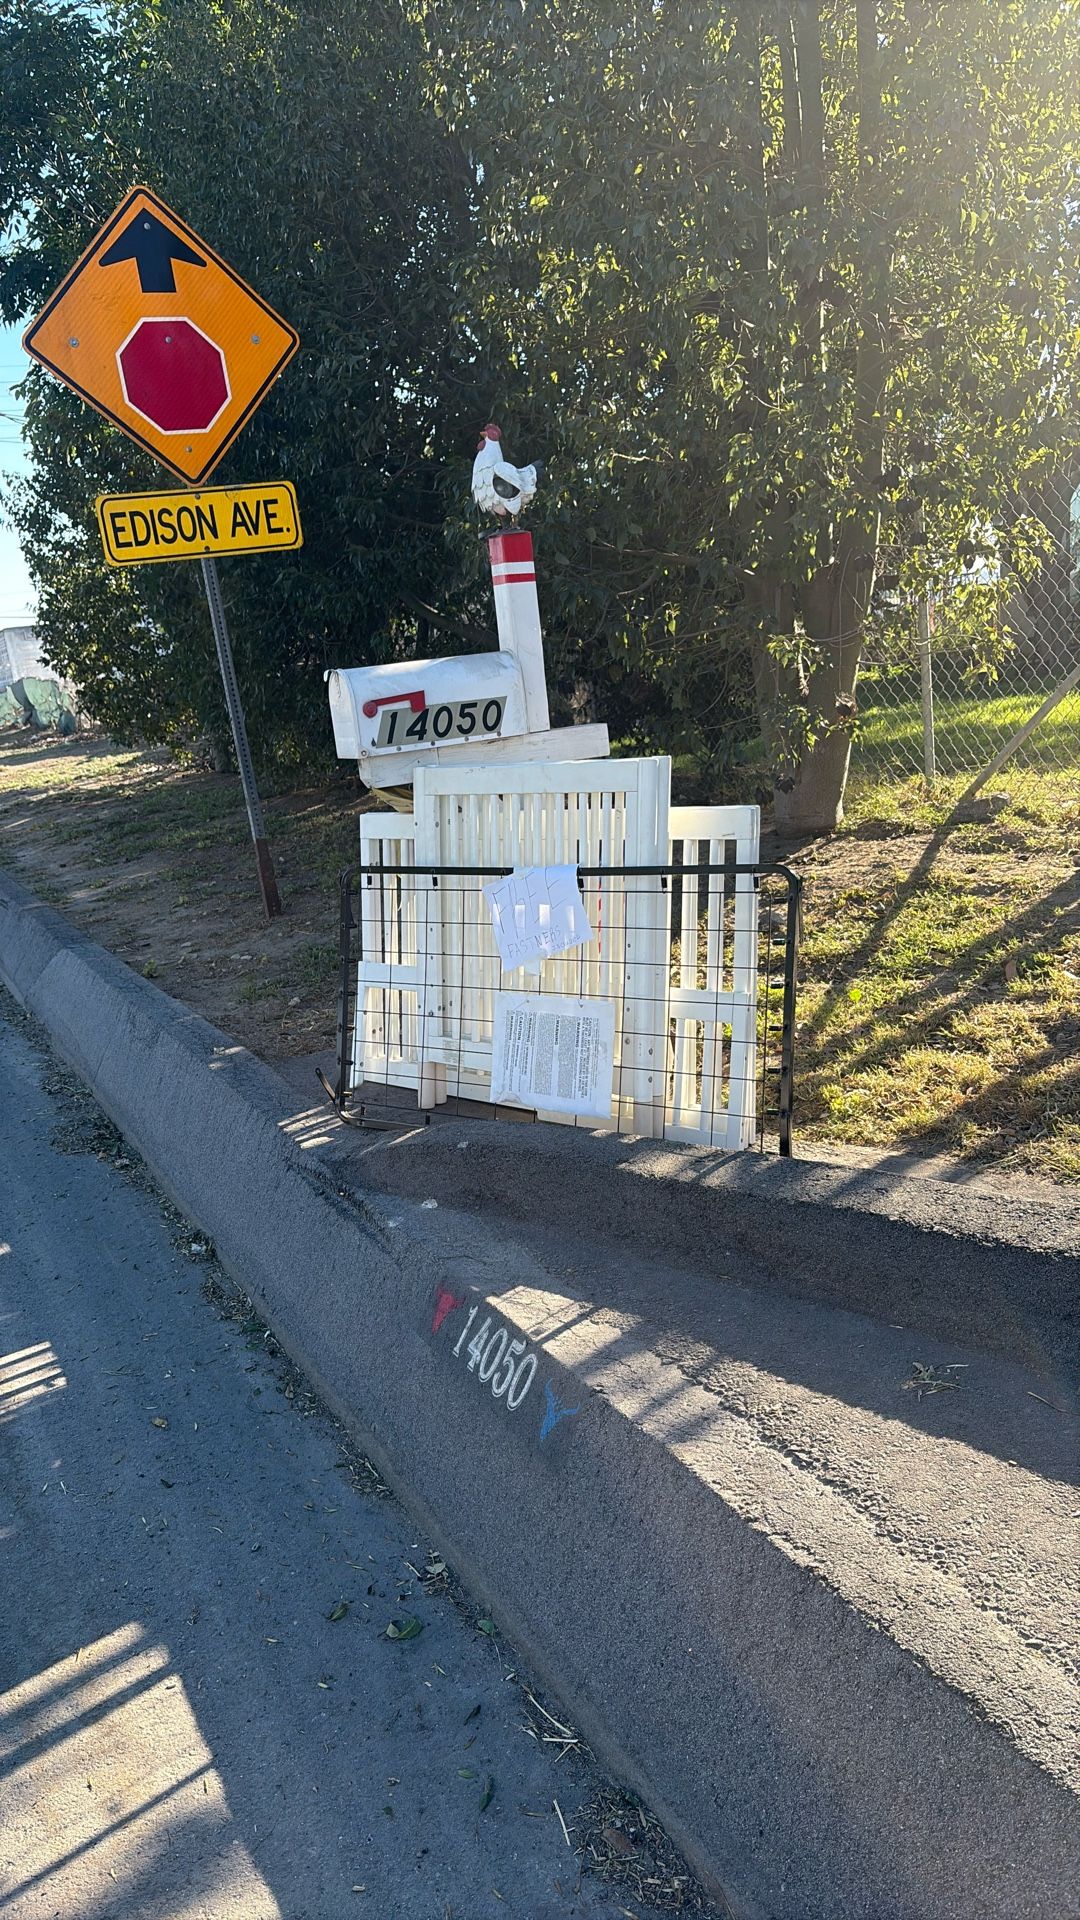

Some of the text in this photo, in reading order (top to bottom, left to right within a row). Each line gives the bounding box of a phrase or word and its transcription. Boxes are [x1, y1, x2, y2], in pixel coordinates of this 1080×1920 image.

[109, 498, 291, 549] EDISON AVE.
[386, 698, 503, 745] 14050
[491, 866, 569, 940] FREE
[452, 1305, 539, 1411] 14050
